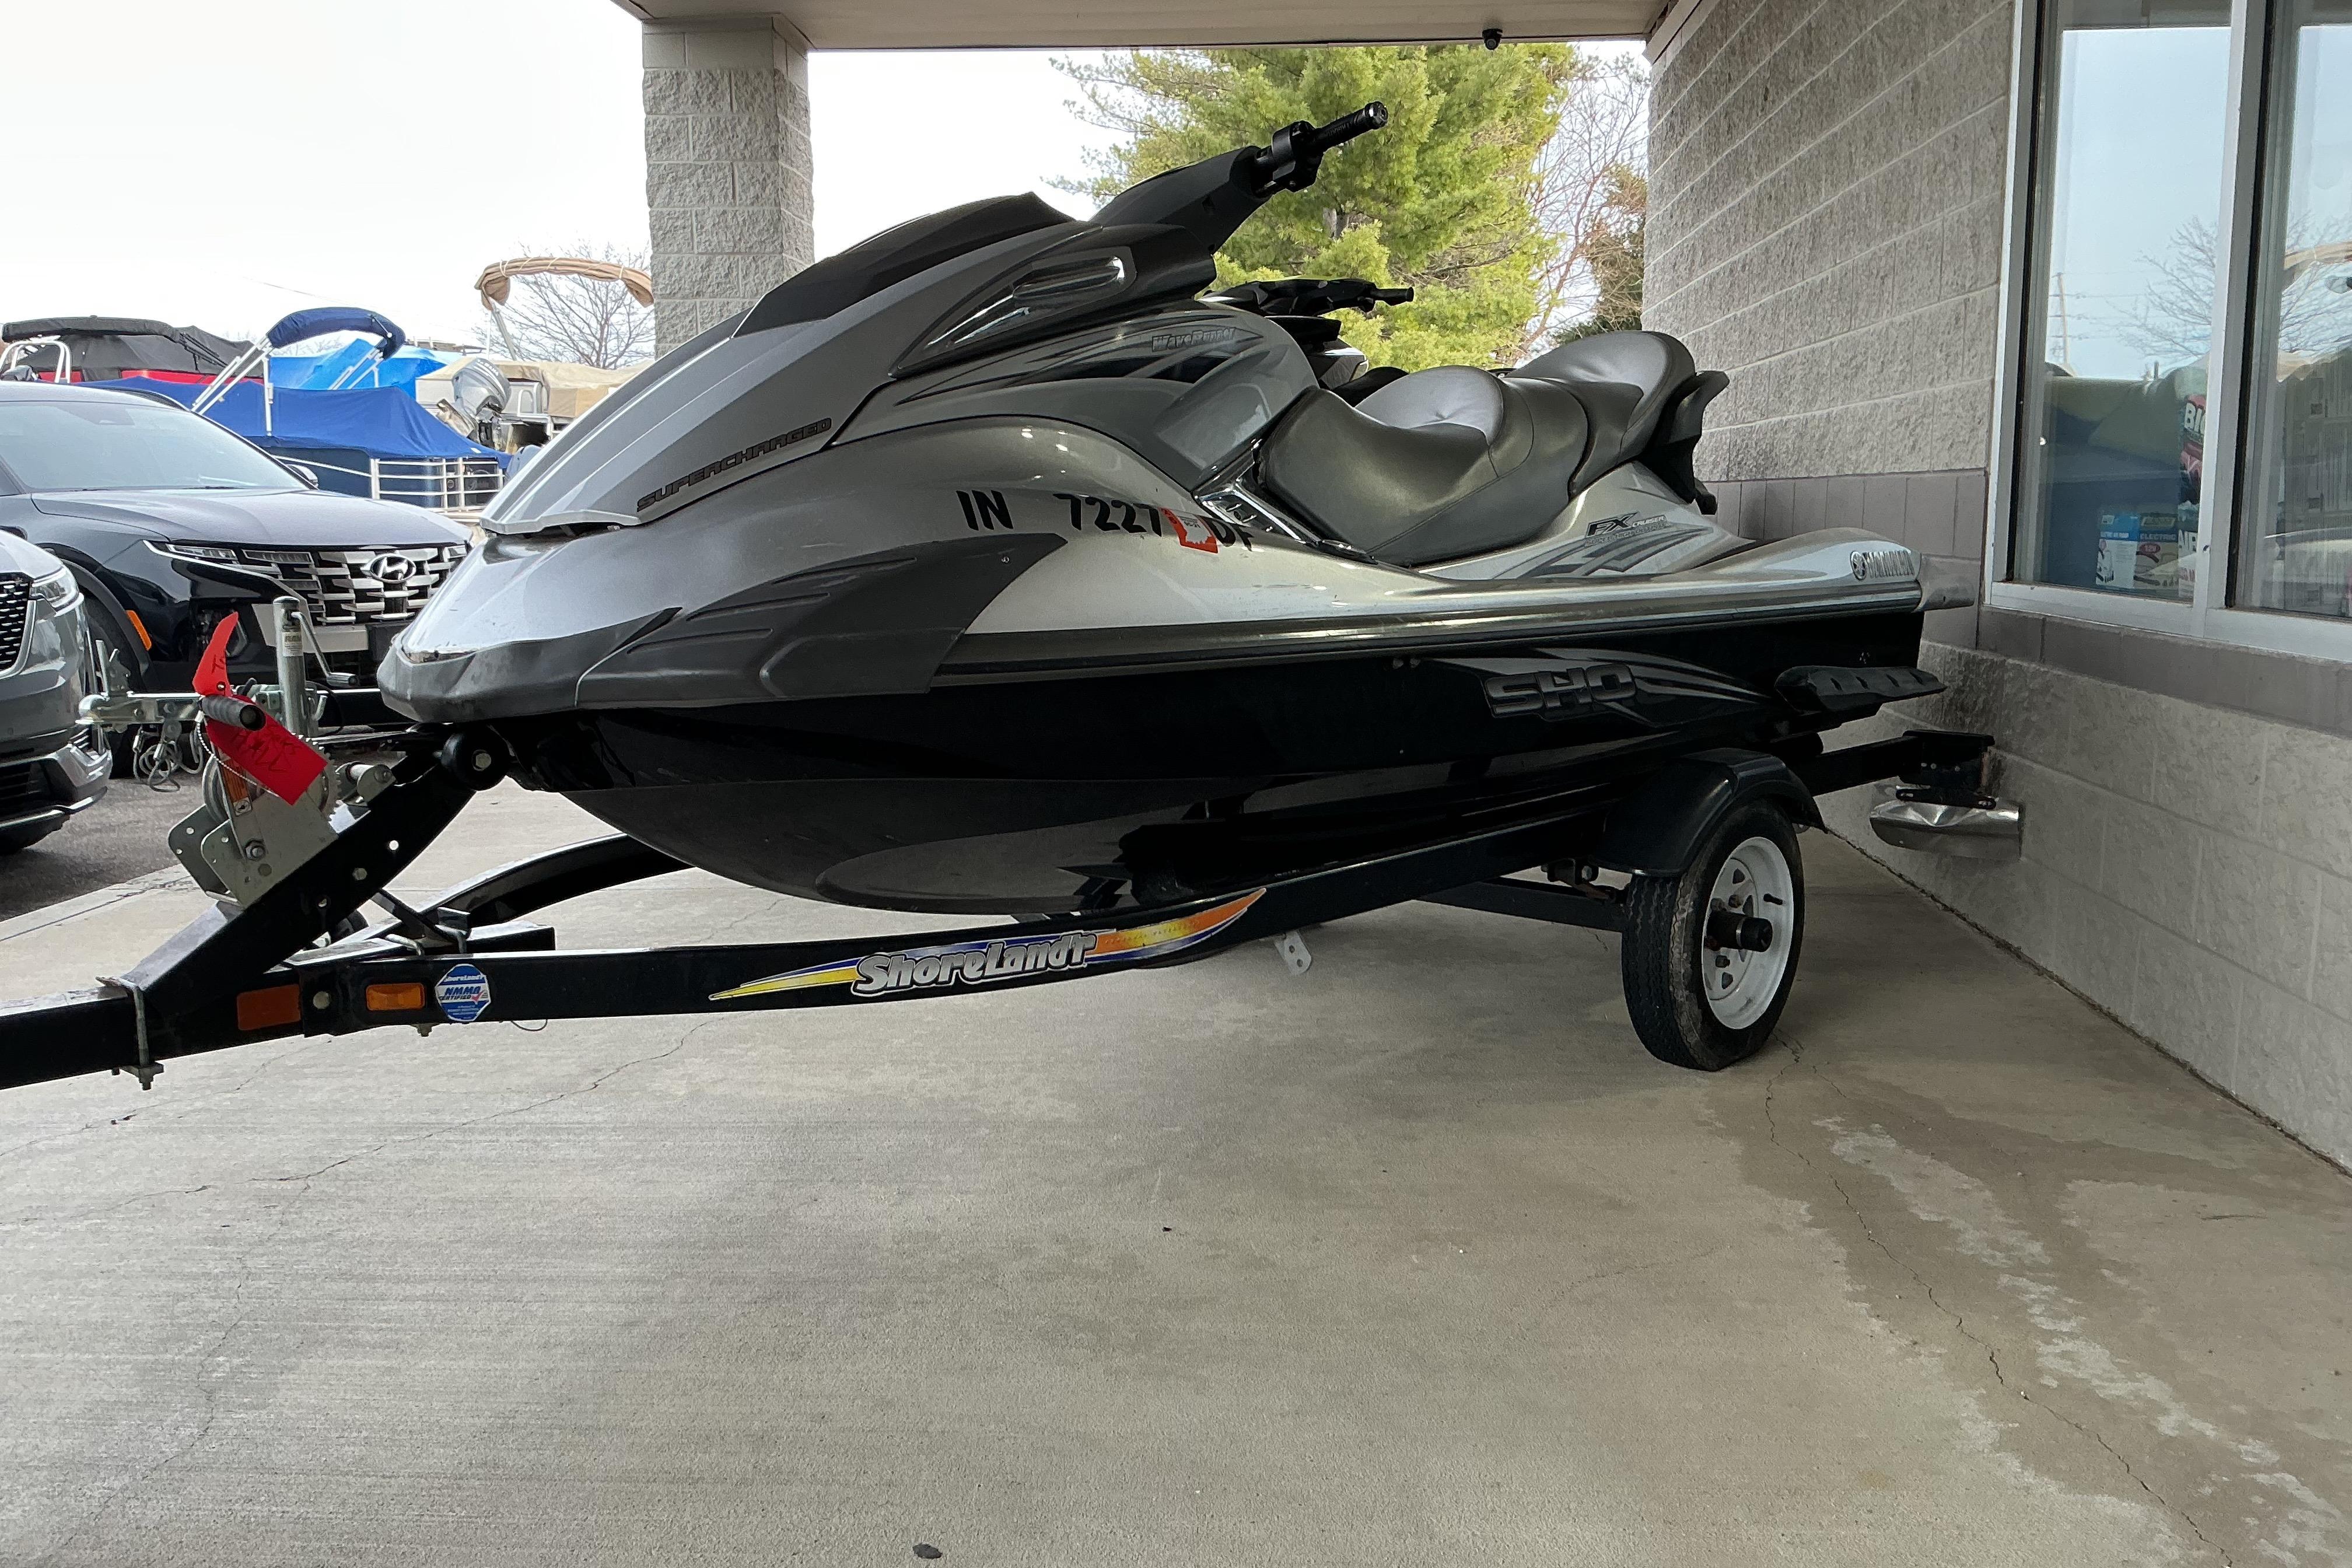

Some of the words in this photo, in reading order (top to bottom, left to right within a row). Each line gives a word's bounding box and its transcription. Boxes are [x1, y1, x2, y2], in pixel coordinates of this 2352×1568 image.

[1152, 327, 1236, 351] WaveRunner
[637, 418, 832, 512] SUPERCHARGED
[956, 489, 1014, 531] IN
[1052, 493, 1162, 537] 7227
[1586, 511, 1639, 538] FX
[1485, 664, 1636, 714] SHO
